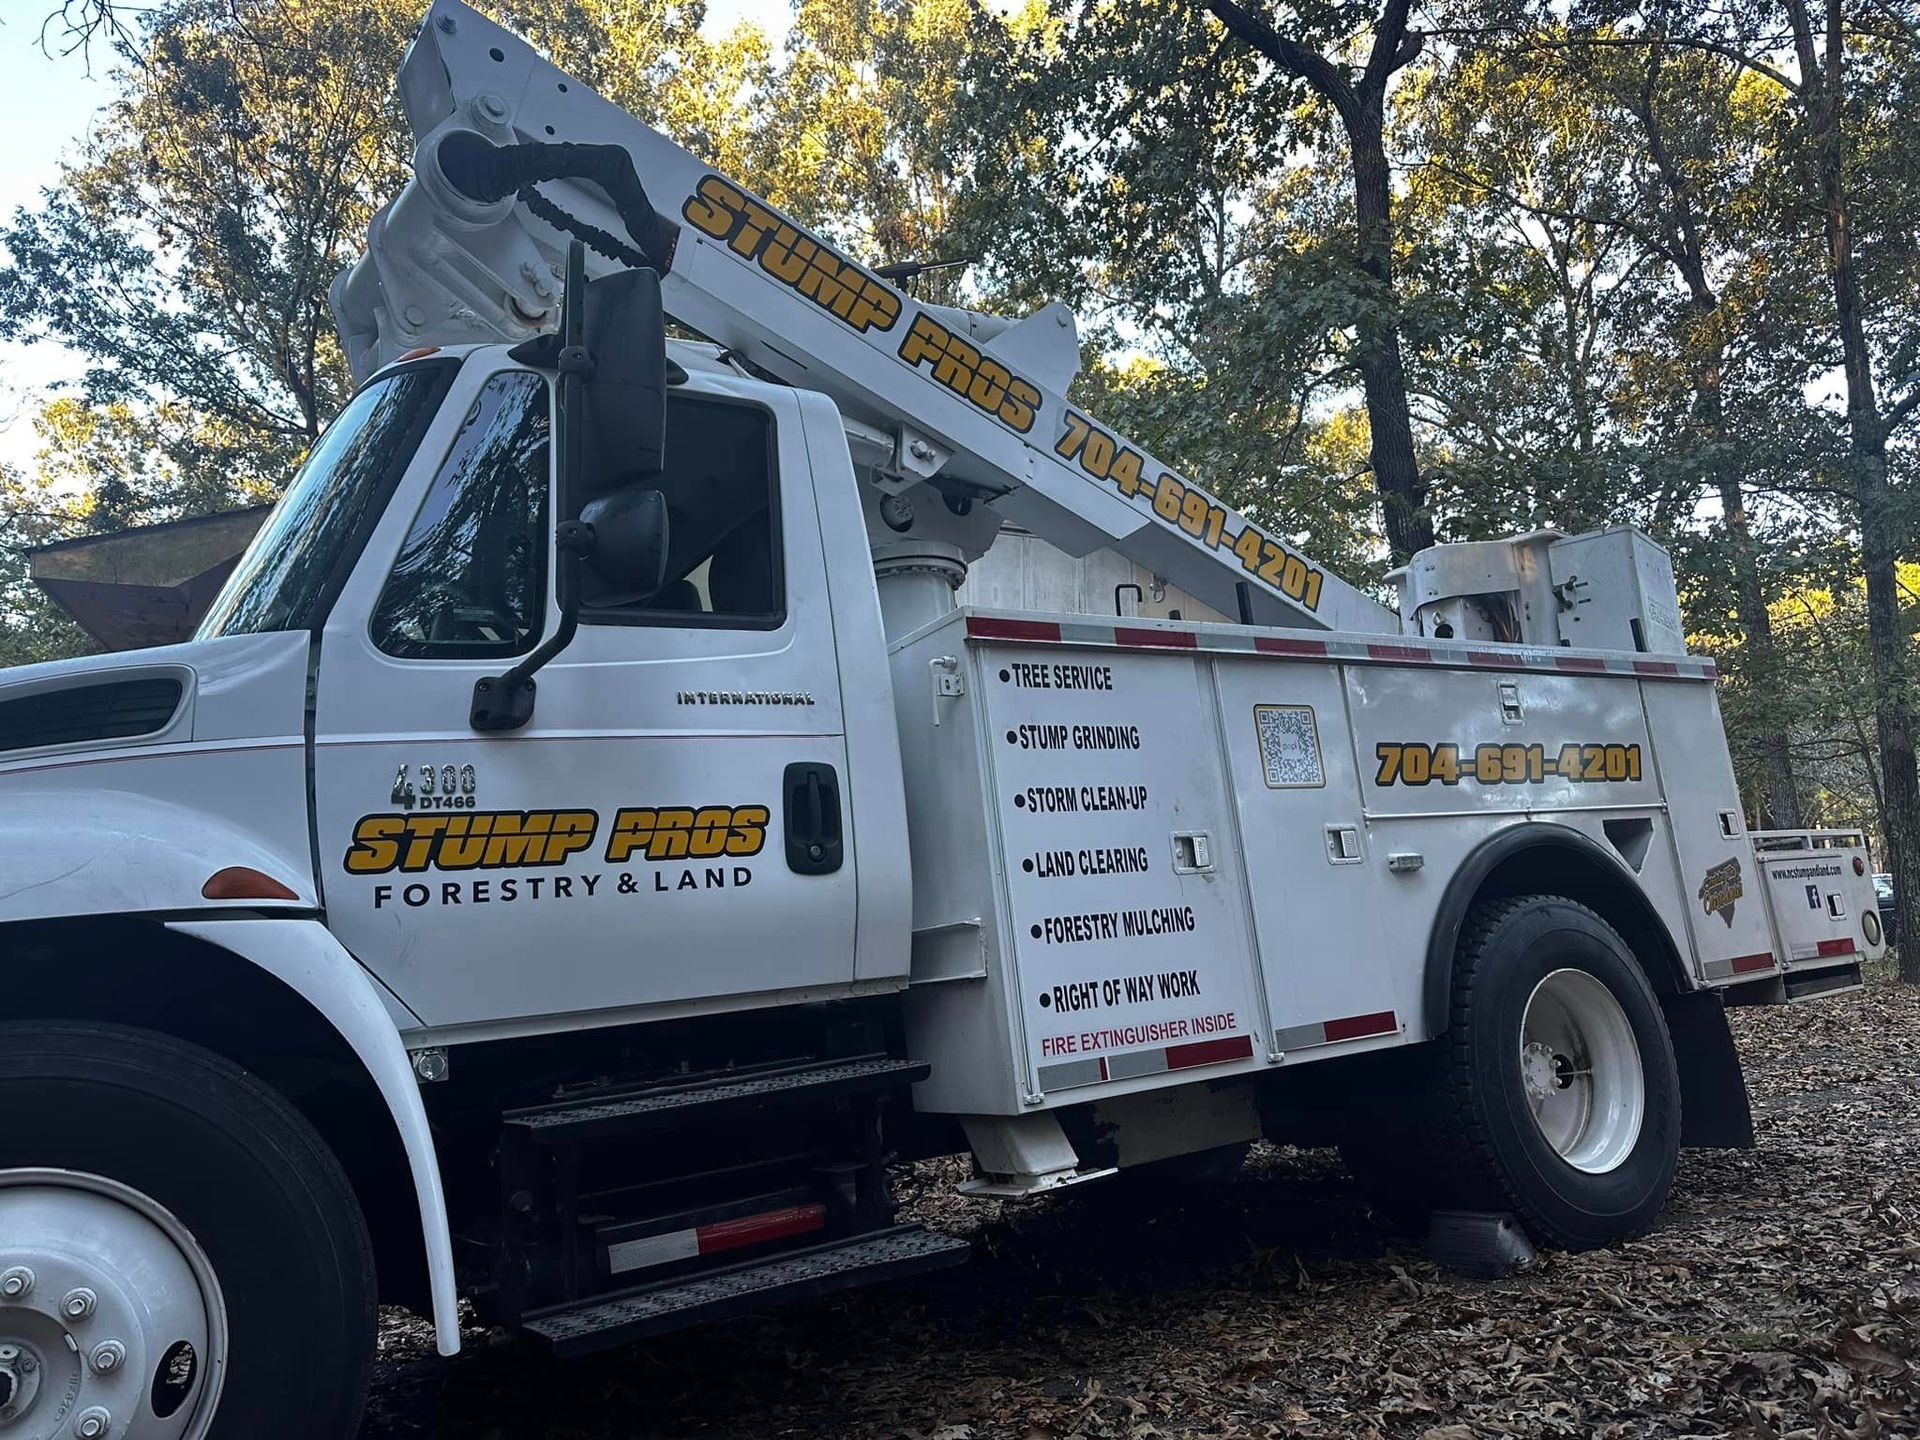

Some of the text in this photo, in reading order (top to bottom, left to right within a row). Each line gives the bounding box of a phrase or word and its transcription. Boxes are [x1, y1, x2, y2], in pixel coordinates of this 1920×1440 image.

[682, 174, 1324, 612] STUMP PROS 704-691-4201
[1012, 663, 1113, 690] TREE SERVICE
[676, 691, 815, 705] INTERNATIONAL
[1020, 724, 1140, 750] STUMP GRINDING
[1376, 742, 1641, 787] 704-691-4201
[391, 764, 476, 810] 4300
[420, 796, 476, 809] DT466
[1027, 786, 1147, 813] STORM CLEAN-UP
[343, 804, 771, 875] STUMP PROS
[1035, 847, 1148, 878] LAND CLEARING
[1771, 864, 1842, 881] www.ncstumpandland.com
[374, 866, 752, 909] FORESTRY & LAND
[1044, 906, 1195, 944] FORESTRY MULCHING
[1053, 970, 1200, 1013] RIGHT OF WAY WORK
[1042, 1012, 1236, 1056] FIRE EXTINGUISHER INSIDE
